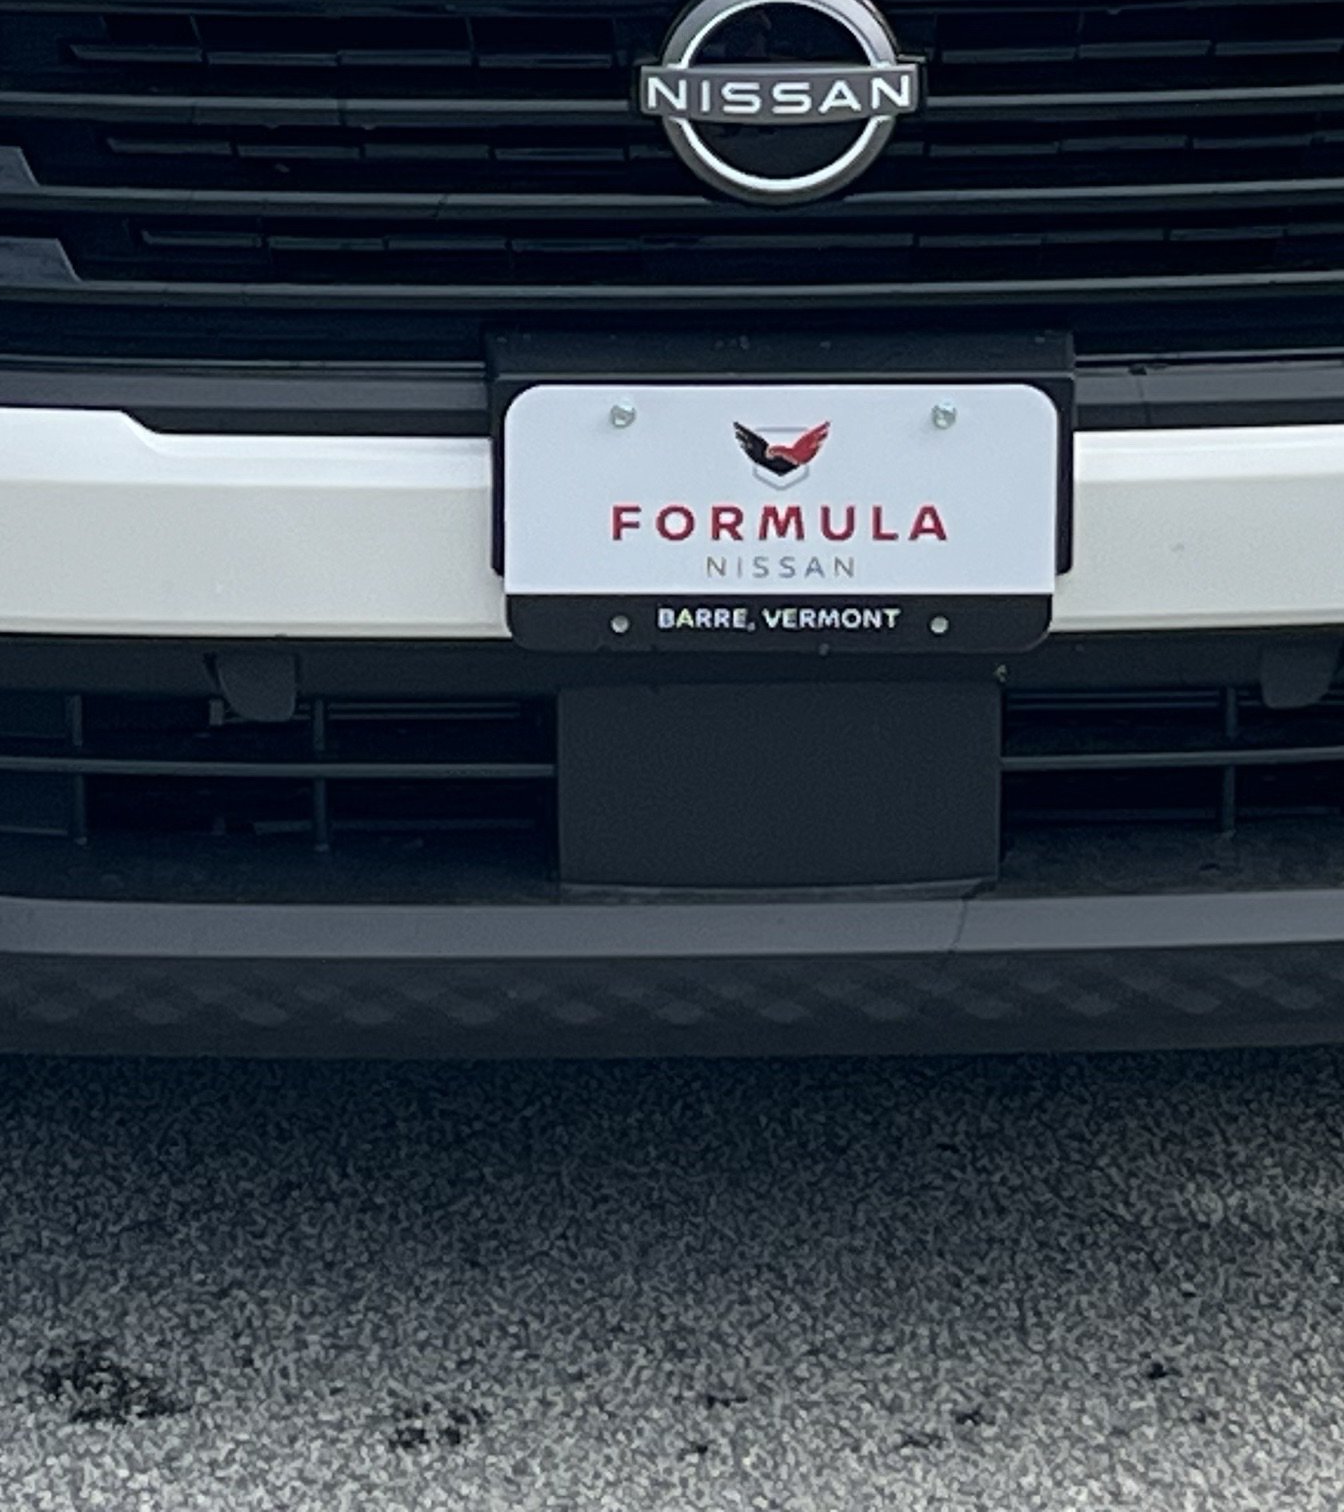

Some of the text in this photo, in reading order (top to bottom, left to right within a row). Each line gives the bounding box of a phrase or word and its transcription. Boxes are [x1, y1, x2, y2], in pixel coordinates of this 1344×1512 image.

[646, 75, 912, 115] NISSAN
[611, 504, 948, 541] FORMULA
[706, 556, 856, 579] NISSAN
[657, 607, 902, 631] BARRE, VERMONT
